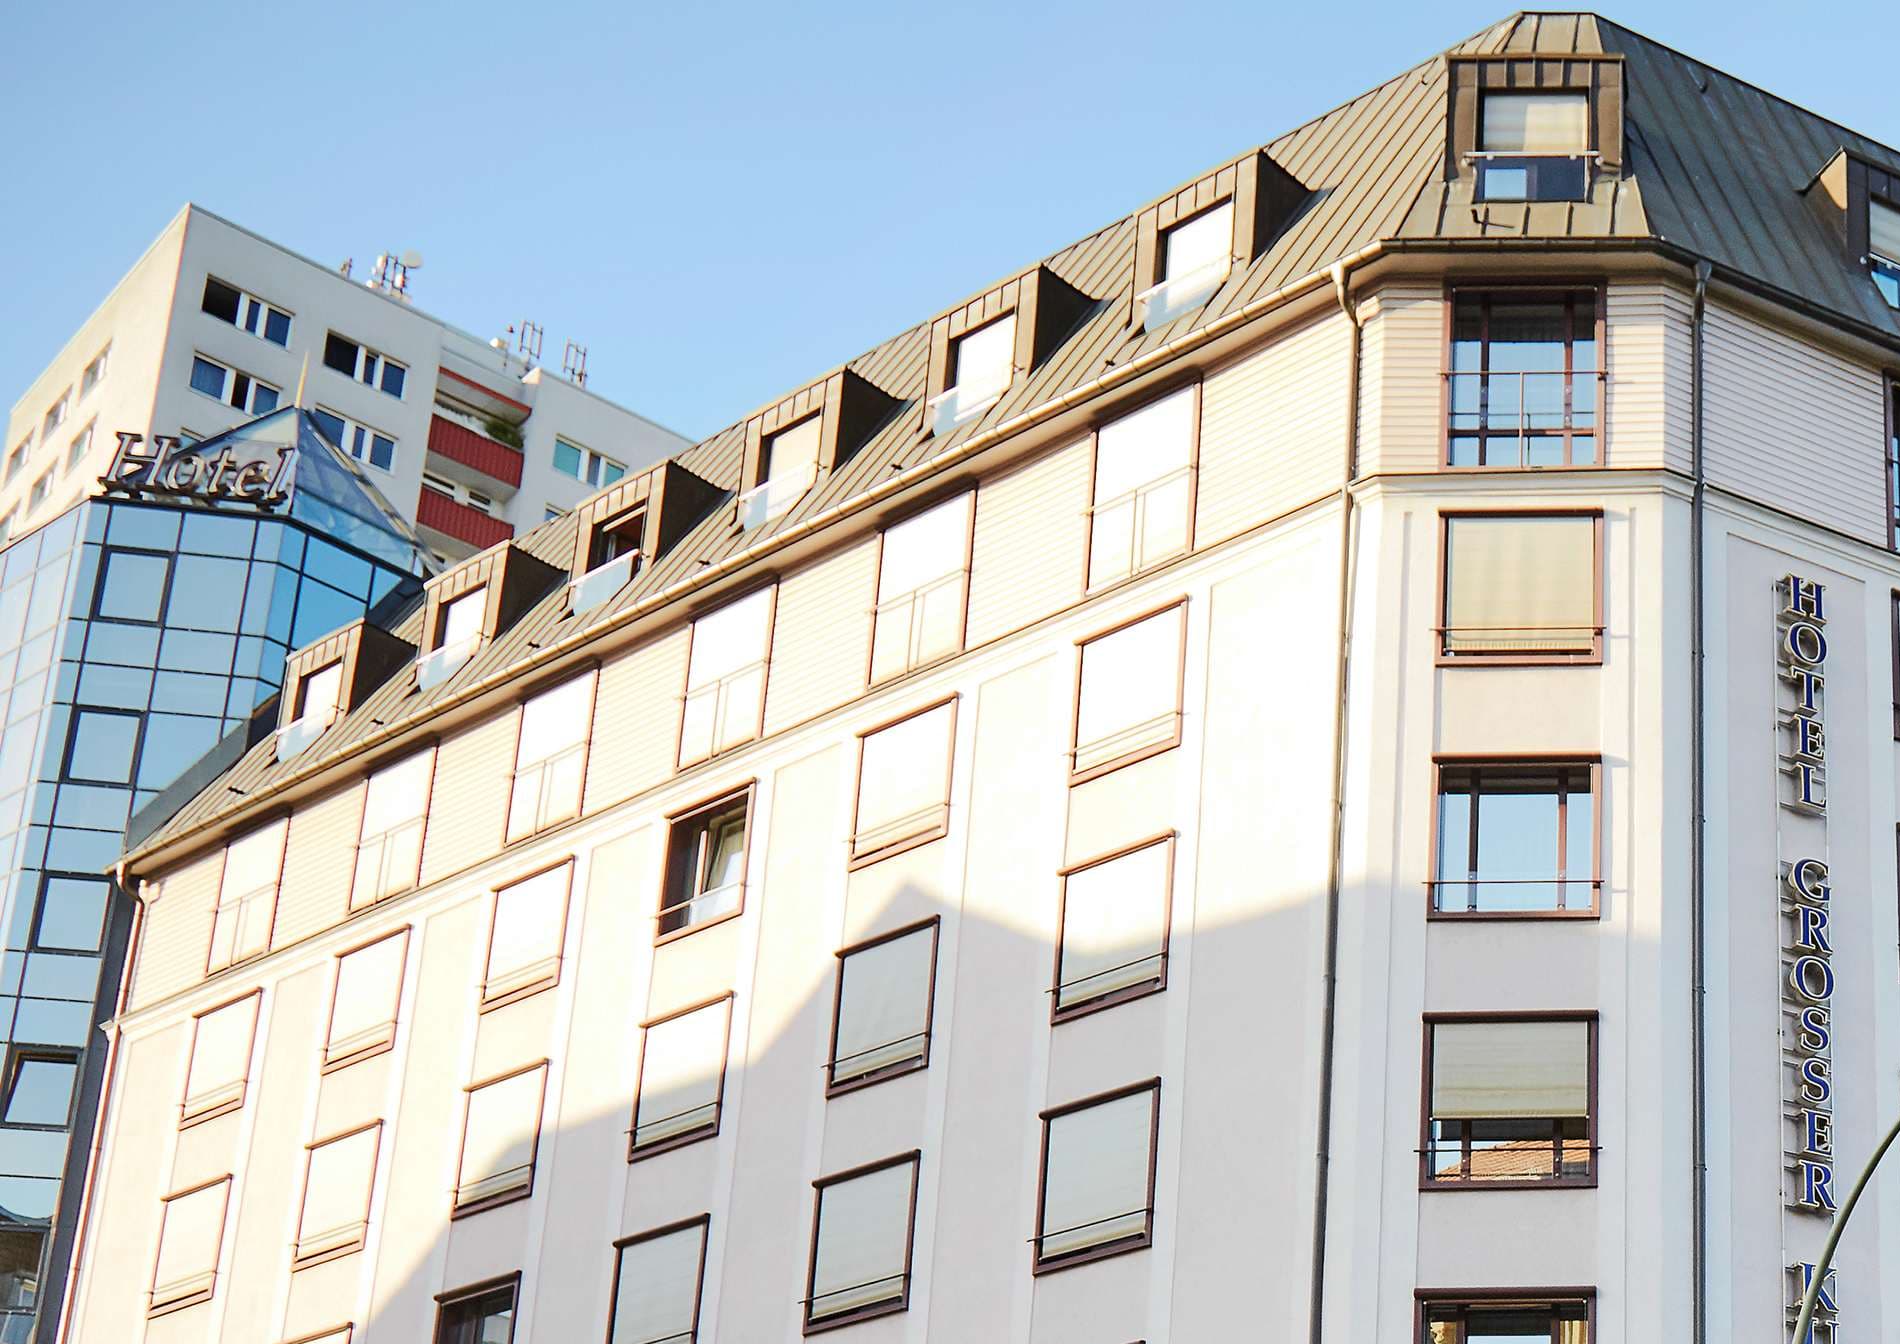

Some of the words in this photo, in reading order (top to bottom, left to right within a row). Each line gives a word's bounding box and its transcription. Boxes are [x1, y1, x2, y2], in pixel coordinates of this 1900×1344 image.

[98, 431, 296, 501] Hotel
[1783, 573, 1827, 808] HOTEL
[1792, 857, 1837, 1211] GROSSER
